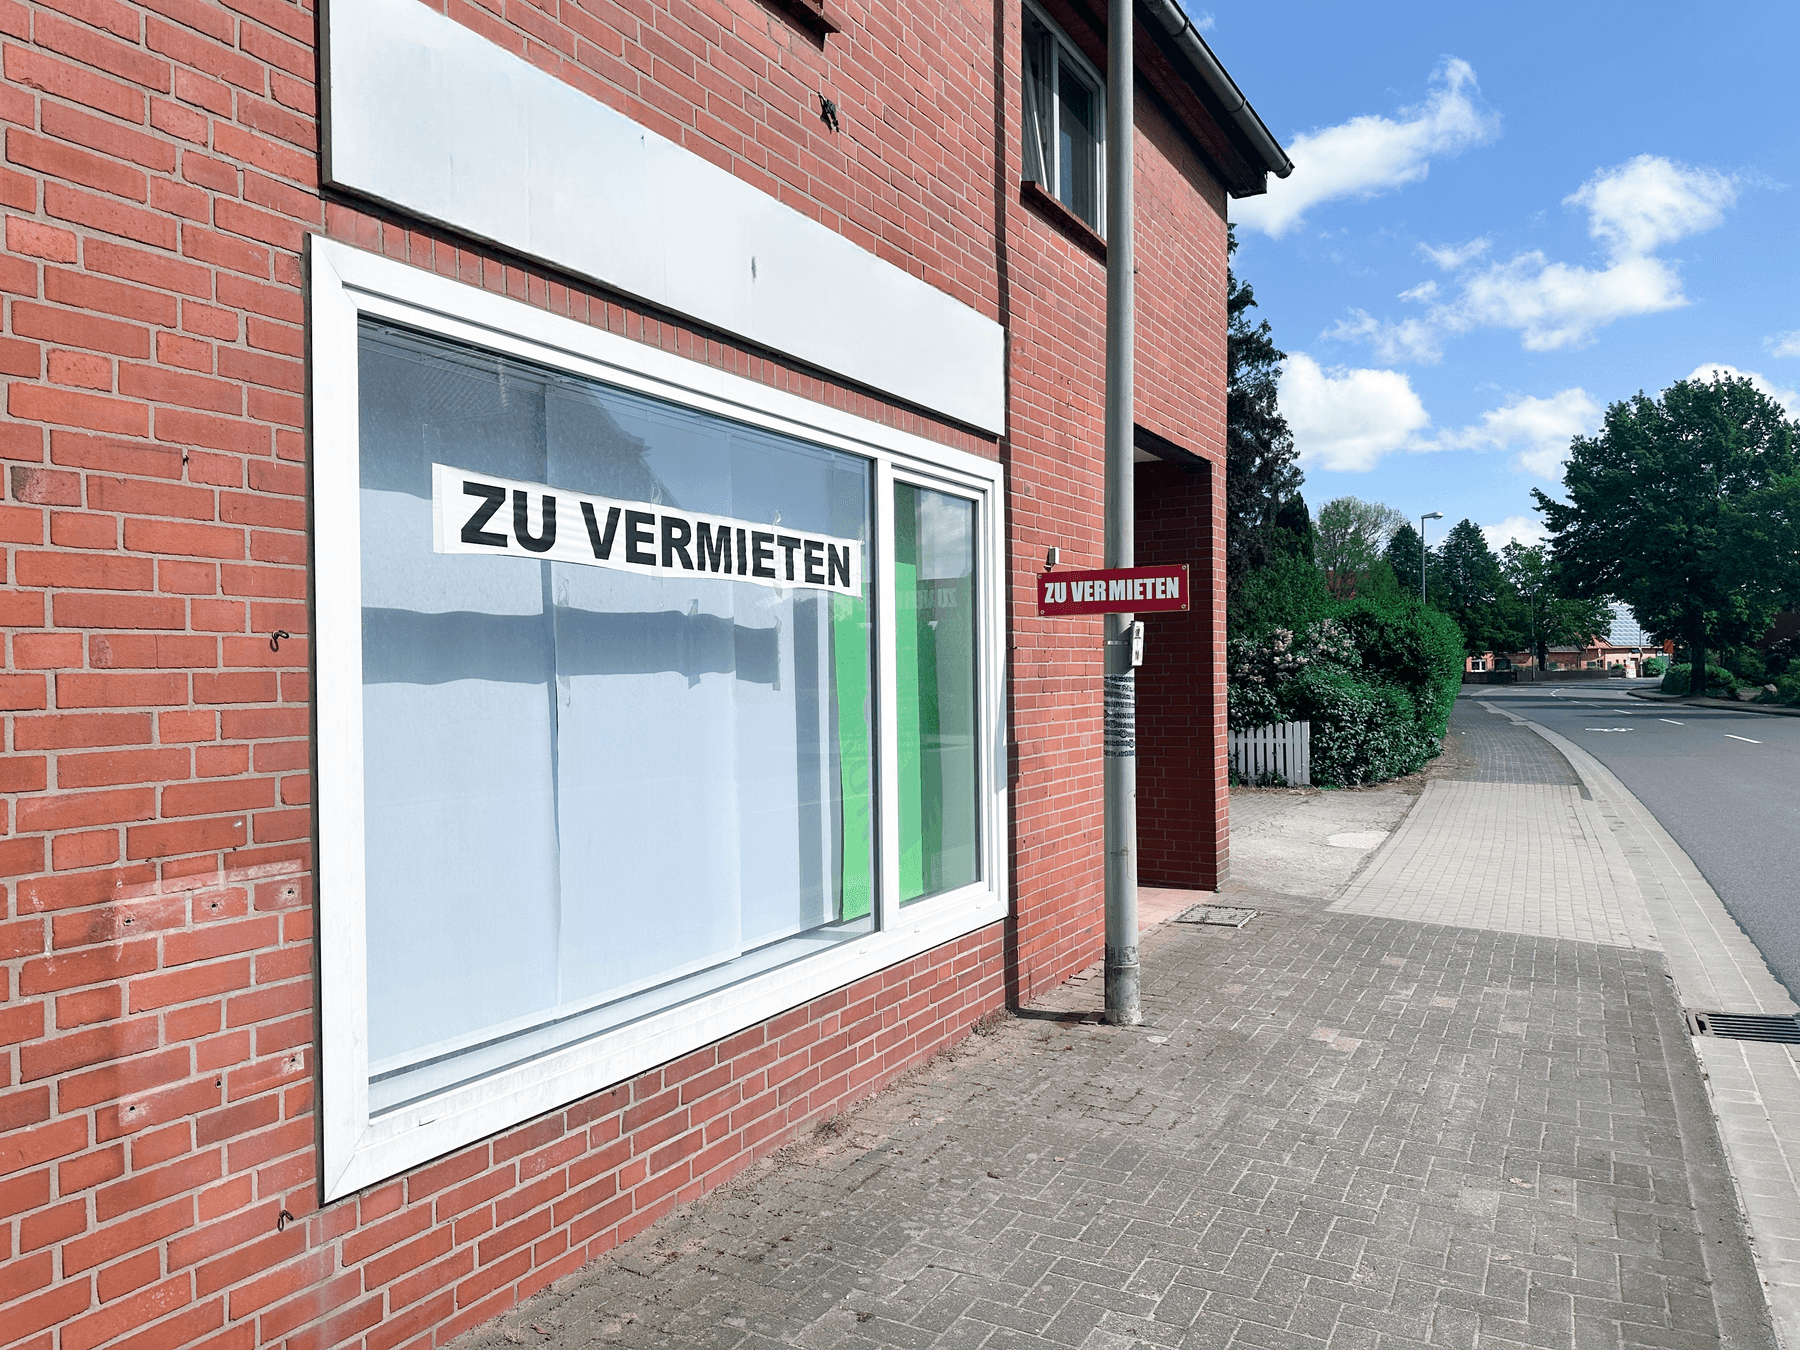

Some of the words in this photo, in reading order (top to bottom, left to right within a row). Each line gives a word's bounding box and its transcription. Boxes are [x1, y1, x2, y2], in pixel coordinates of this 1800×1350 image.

[461, 480, 556, 553] ZU
[579, 501, 850, 588] VERMIETEN
[1044, 581, 1067, 604] ZU
